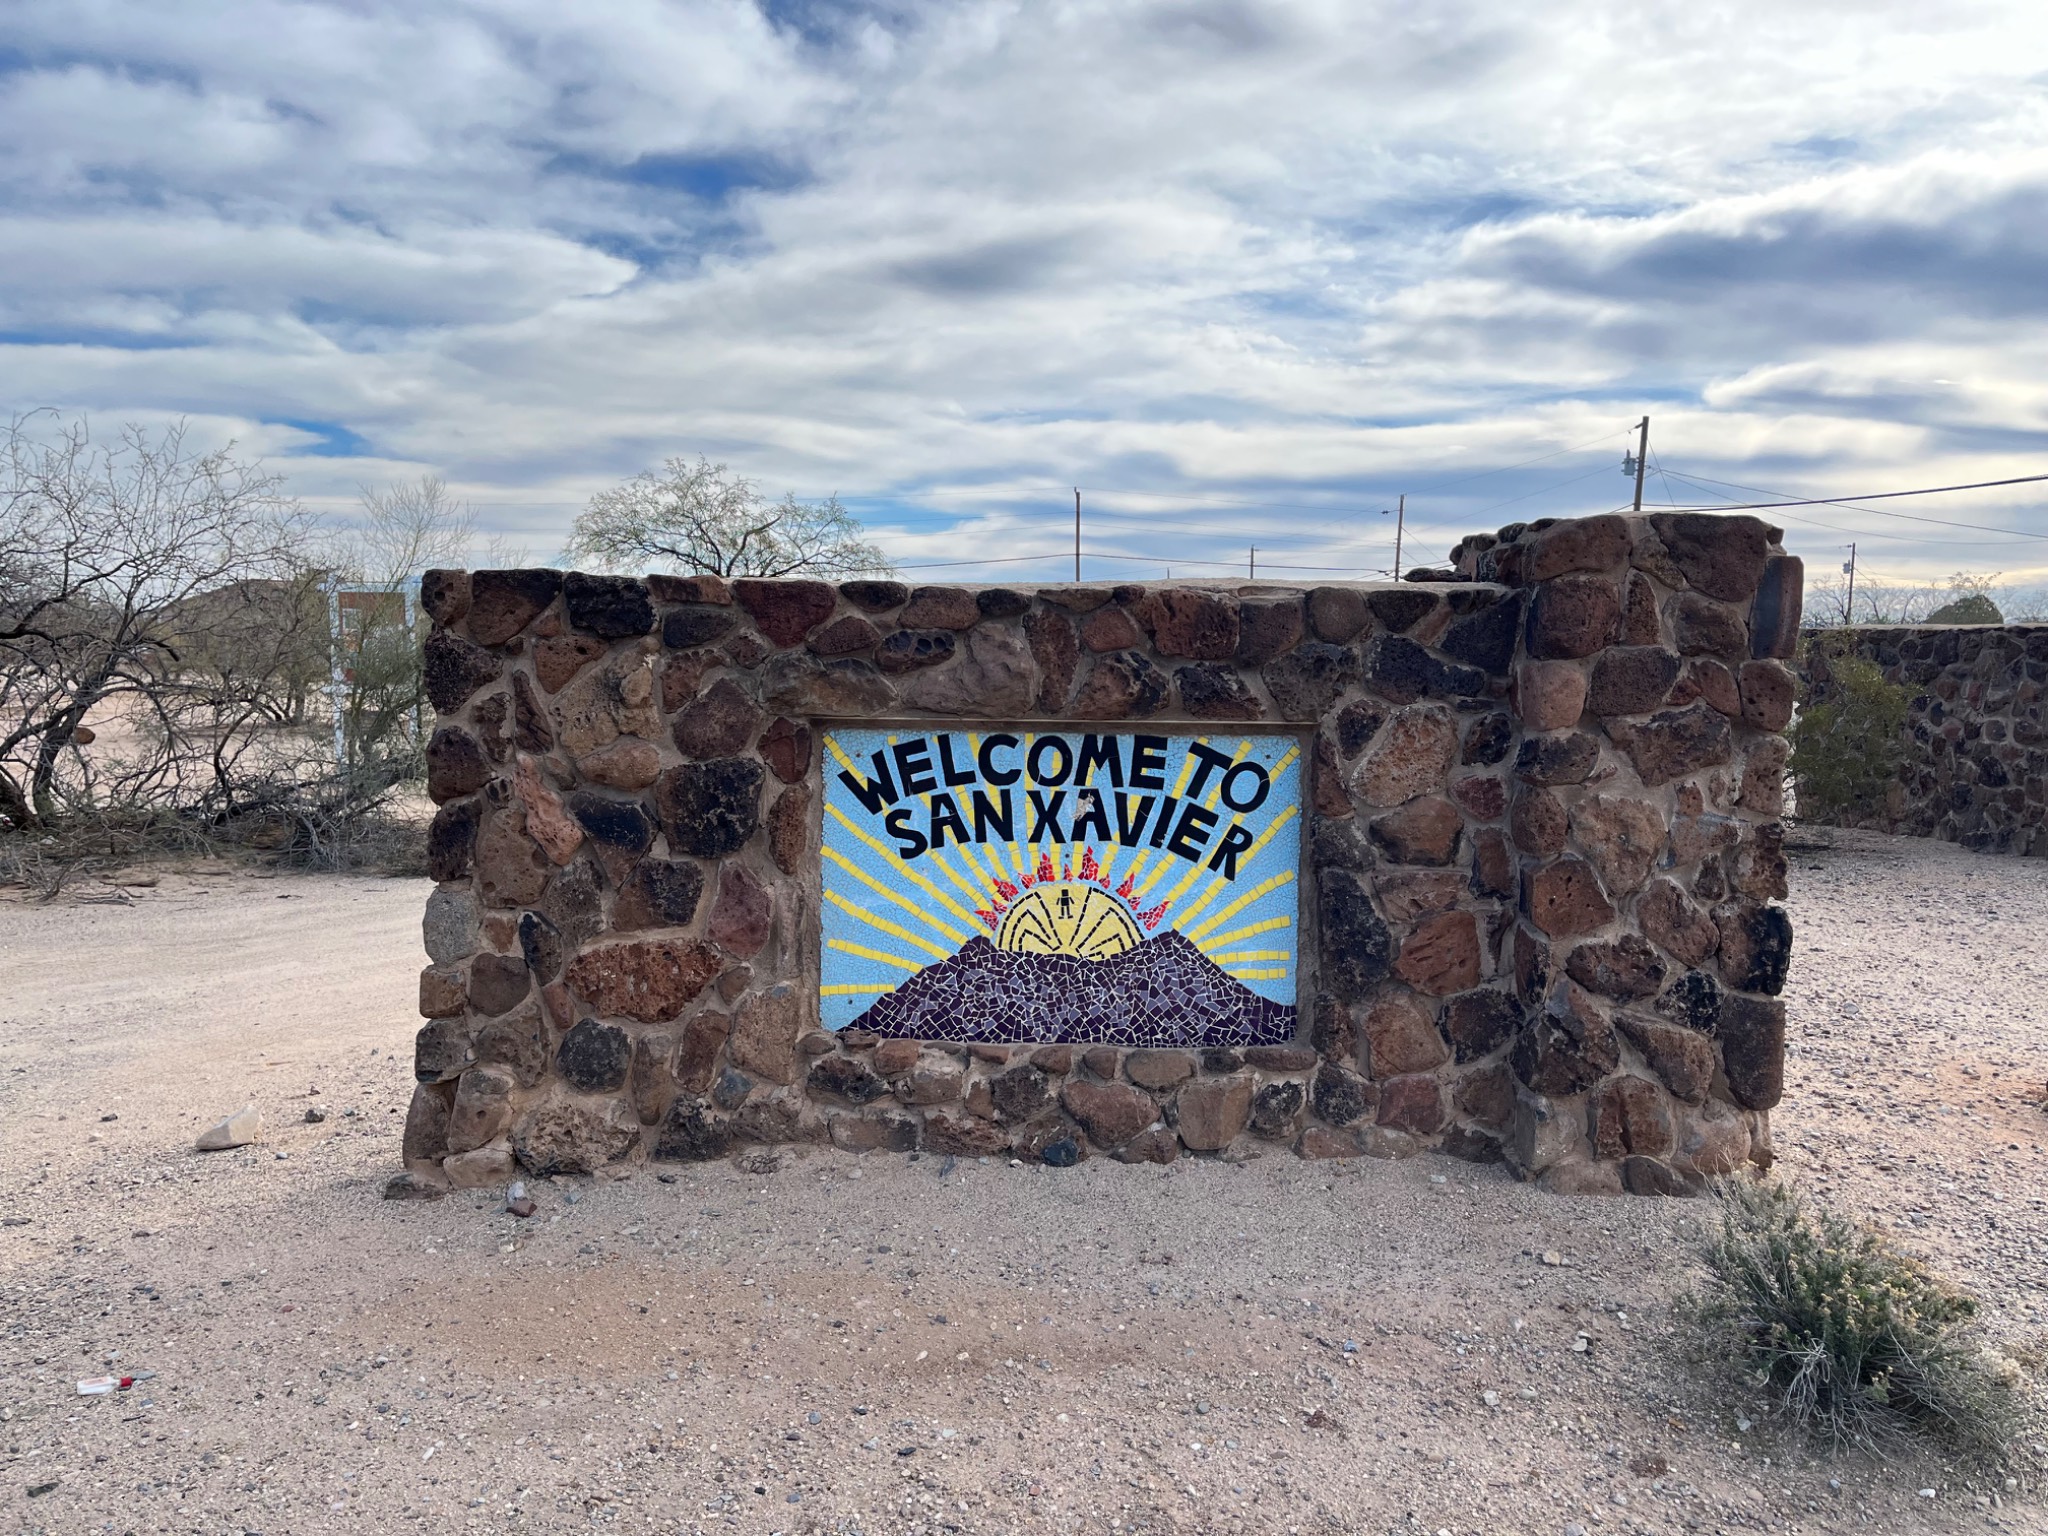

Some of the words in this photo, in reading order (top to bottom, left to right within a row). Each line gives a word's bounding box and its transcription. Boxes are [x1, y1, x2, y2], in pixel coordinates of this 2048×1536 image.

[837, 733, 1170, 816] WELCOME
[1184, 740, 1271, 814] TO
[884, 789, 1015, 860] SAN
[1027, 788, 1254, 882] XAVIER
